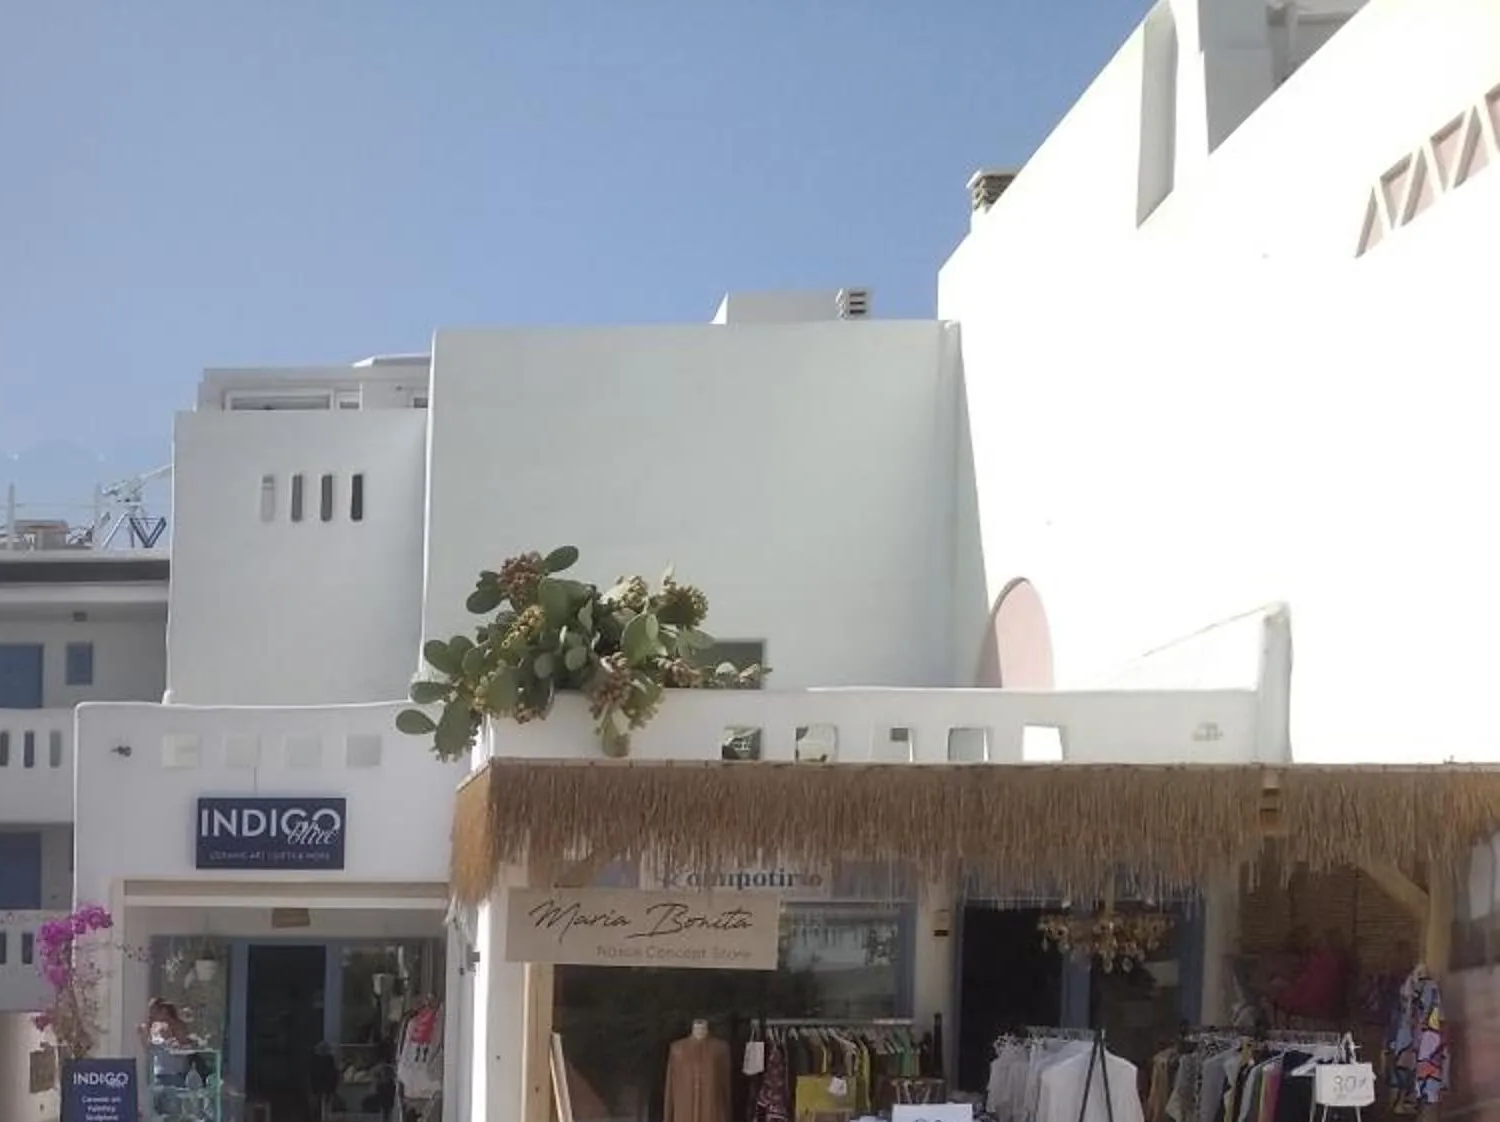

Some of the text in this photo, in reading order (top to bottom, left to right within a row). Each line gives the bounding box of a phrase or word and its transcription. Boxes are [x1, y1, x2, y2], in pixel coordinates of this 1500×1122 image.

[201, 808, 341, 837] INDIGO
[528, 900, 753, 944] Maria Bonita
[73, 1071, 129, 1086] INDIGO
